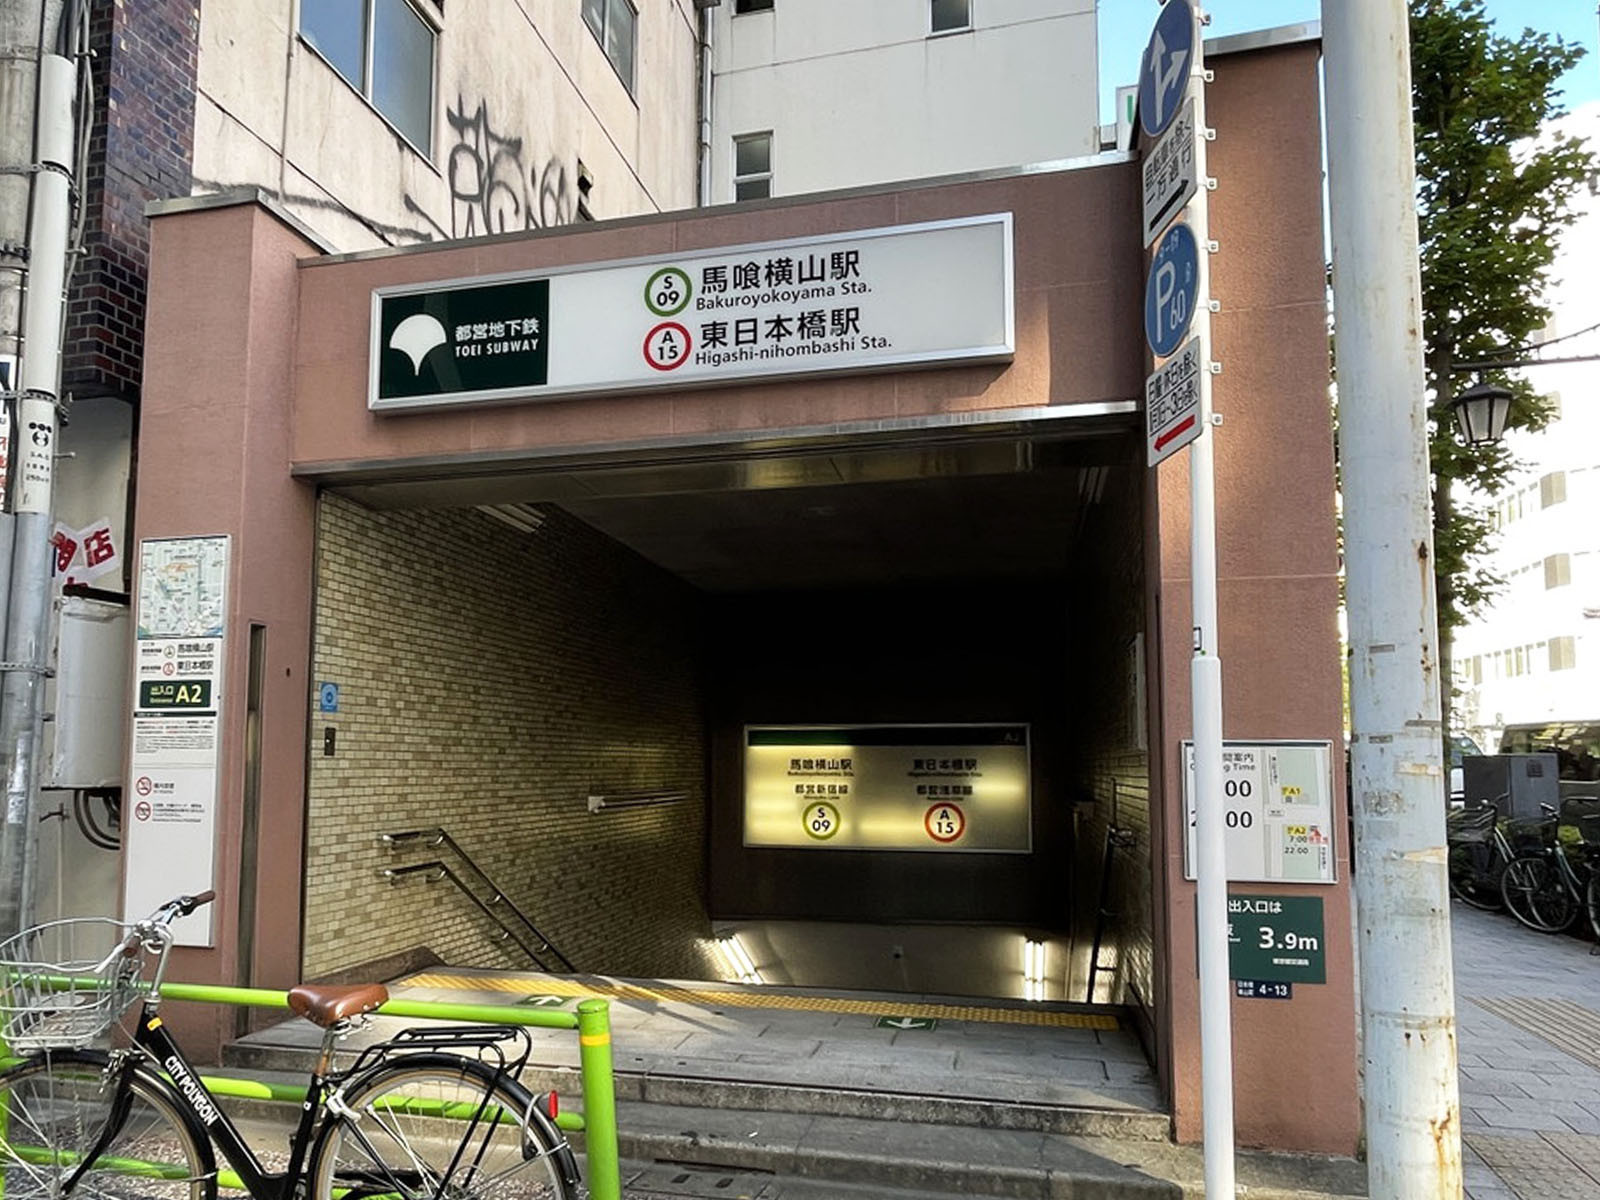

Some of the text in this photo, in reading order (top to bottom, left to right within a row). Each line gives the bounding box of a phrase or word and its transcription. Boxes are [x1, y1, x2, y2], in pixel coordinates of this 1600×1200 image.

[1146, 138, 1192, 206] 一方通行
[702, 250, 860, 294] 馬喰横山駅
[663, 275, 673, 289] S
[657, 290, 680, 306] 09
[696, 281, 872, 311] Bakuroyokoyama Sta.
[1156, 260, 1176, 343] P
[1170, 289, 1186, 330] 60
[455, 318, 539, 341] 都営地下鉄
[661, 330, 674, 344] A
[700, 307, 860, 349] 東日本橋駅
[456, 338, 539, 357] TOEI SUBWAY
[658, 345, 678, 360] 15
[696, 336, 893, 367] Higashi-nihombashi Sta.
[175, 684, 202, 703] A2
[818, 807, 826, 818] S
[940, 809, 950, 820] A
[812, 820, 831, 832] 09
[937, 822, 954, 834] 15
[1228, 899, 1282, 914] 出入口は
[1259, 926, 1318, 950] 3.9m
[1259, 984, 1288, 997] 4-13
[165, 1055, 219, 1127] CITY POLYGON
